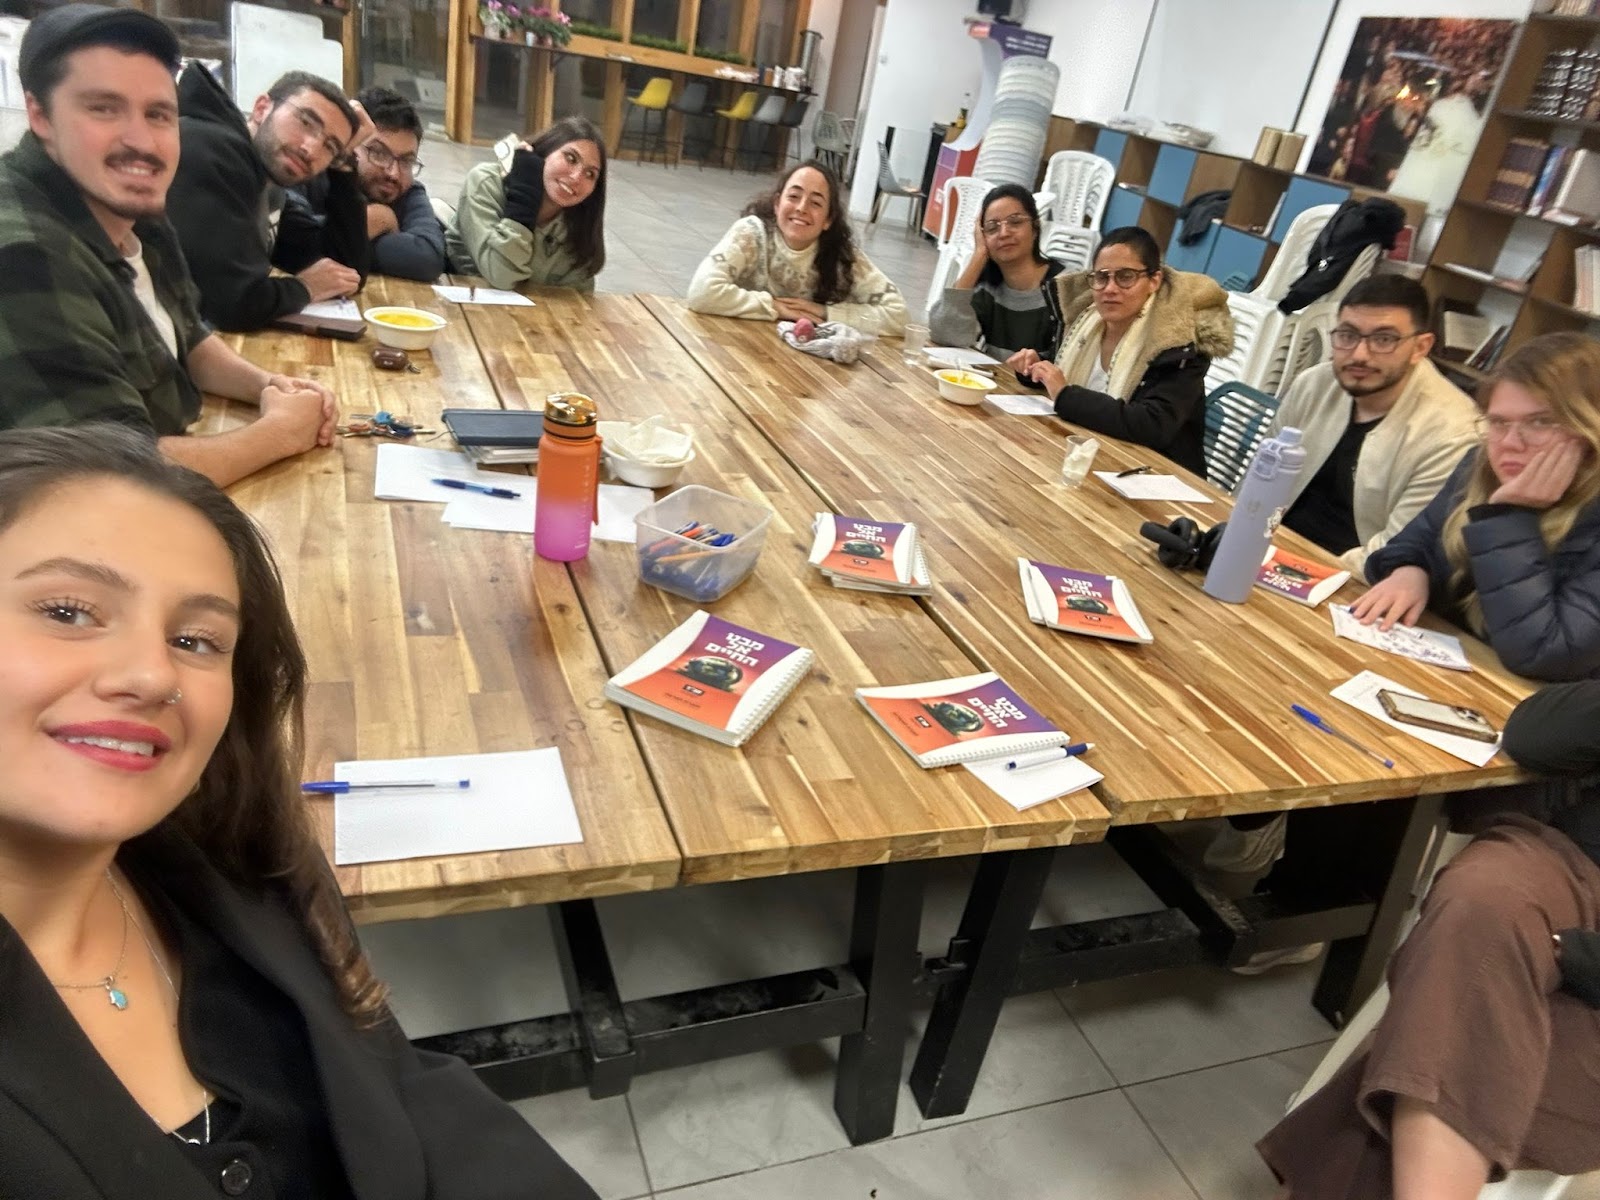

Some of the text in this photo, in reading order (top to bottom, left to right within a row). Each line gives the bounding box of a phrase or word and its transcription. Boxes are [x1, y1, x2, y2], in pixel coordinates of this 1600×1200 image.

[726, 632, 765, 651] מבט
[727, 641, 751, 655] אל
[705, 643, 759, 667] החיים
[968, 697, 1008, 729] החיים
[989, 702, 1011, 718] אל
[995, 697, 1028, 721] מבט
